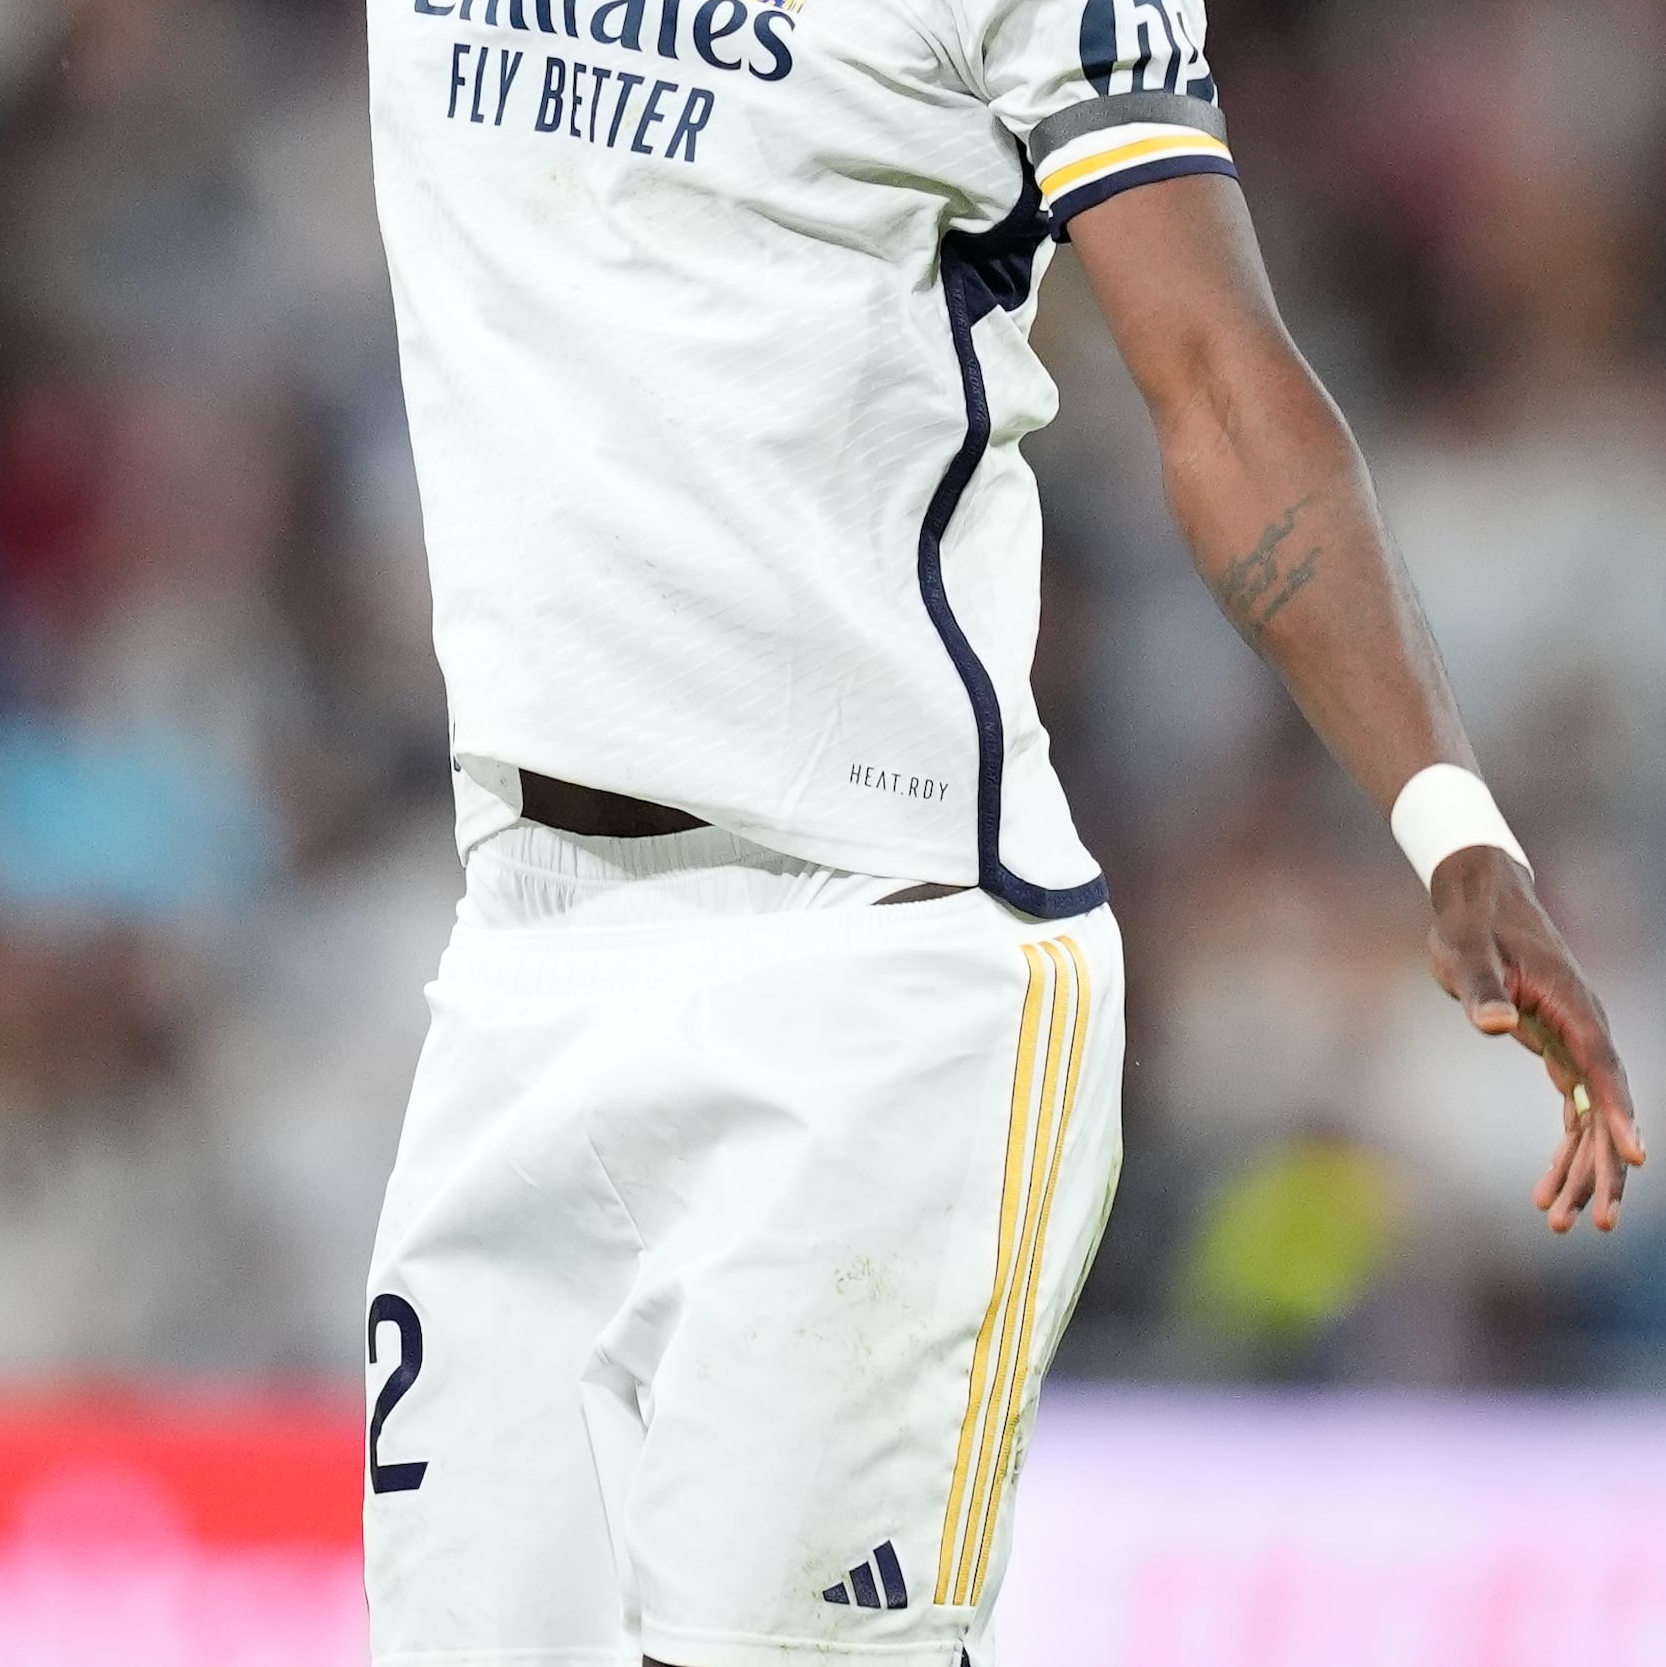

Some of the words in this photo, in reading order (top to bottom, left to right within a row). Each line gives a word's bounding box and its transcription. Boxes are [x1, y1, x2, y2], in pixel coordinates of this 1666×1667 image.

[447, 42, 523, 126] FLY
[534, 56, 715, 163] BETTER
[849, 763, 949, 801] HEAT.RDY
[368, 1293, 429, 1494] 2
